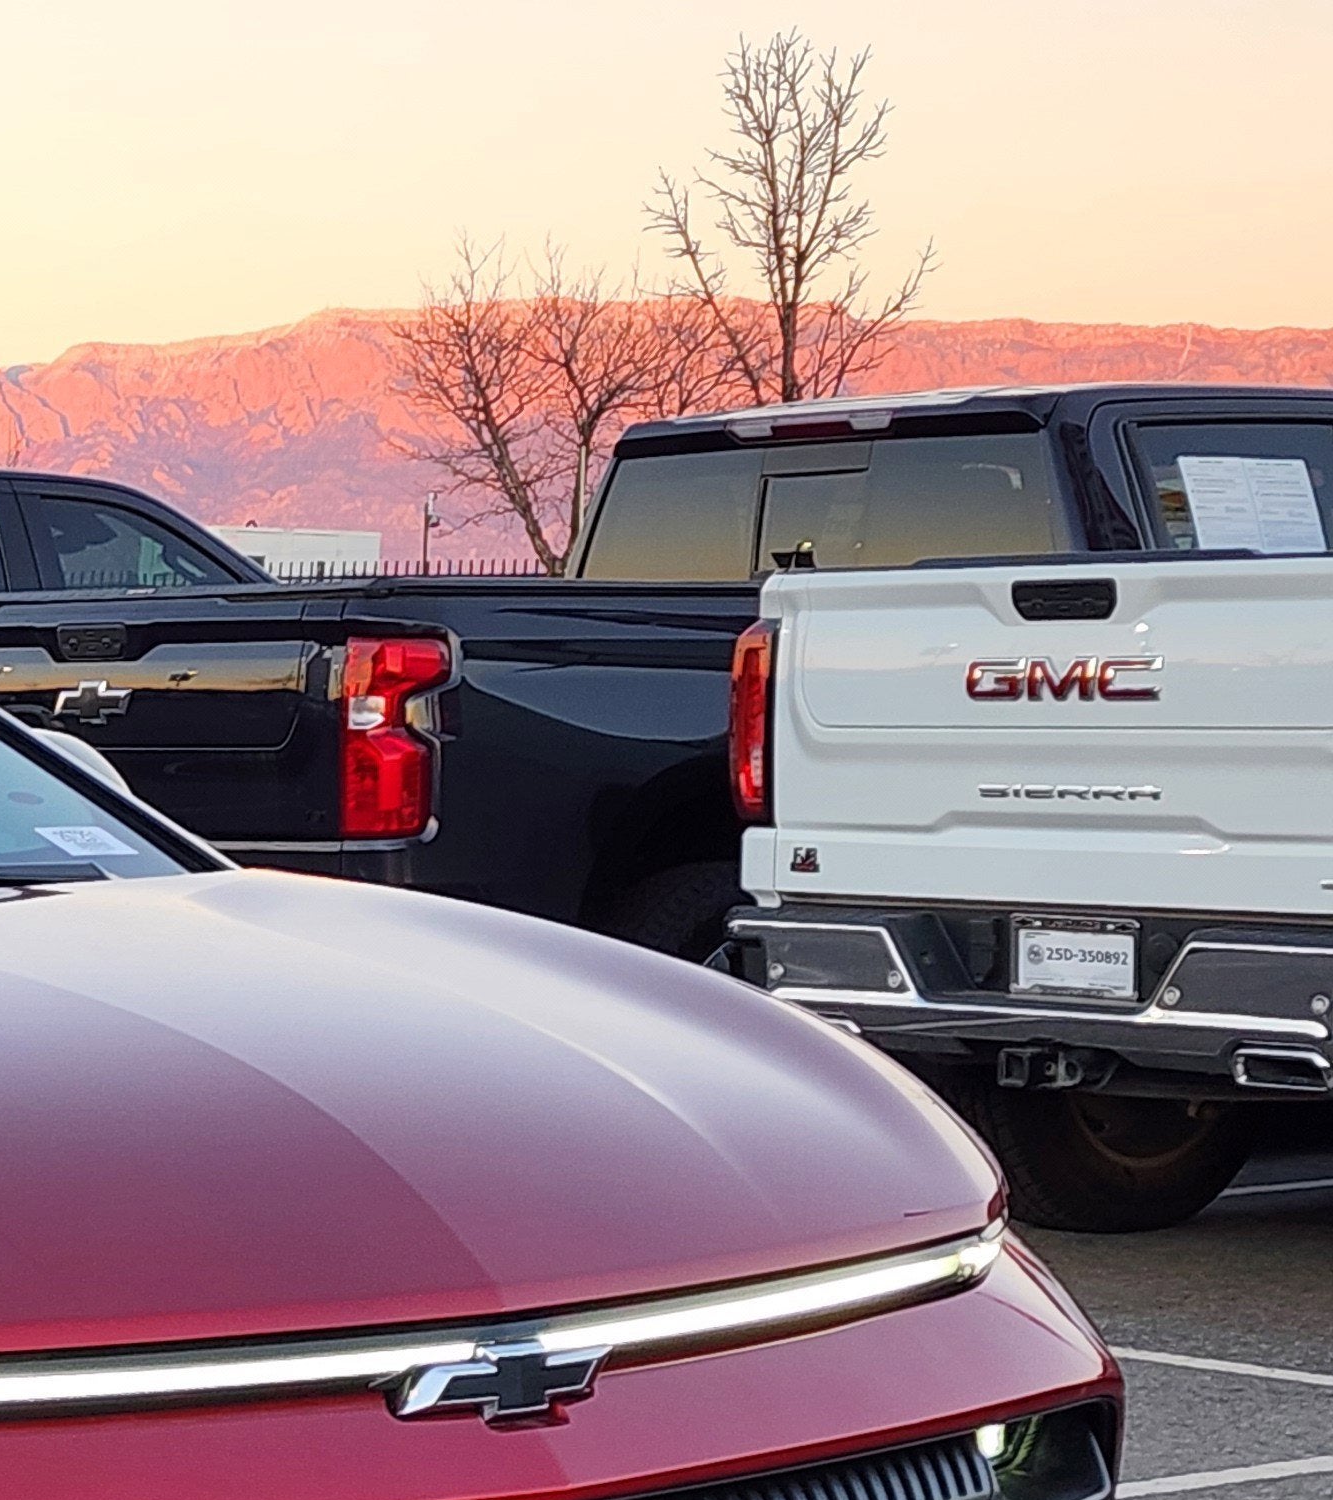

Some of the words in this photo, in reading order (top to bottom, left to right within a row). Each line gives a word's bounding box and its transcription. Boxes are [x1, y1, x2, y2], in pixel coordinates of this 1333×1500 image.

[965, 656, 1164, 702] GMC
[978, 784, 1162, 801] SIERRA
[1046, 946, 1129, 966] 25D-350892
